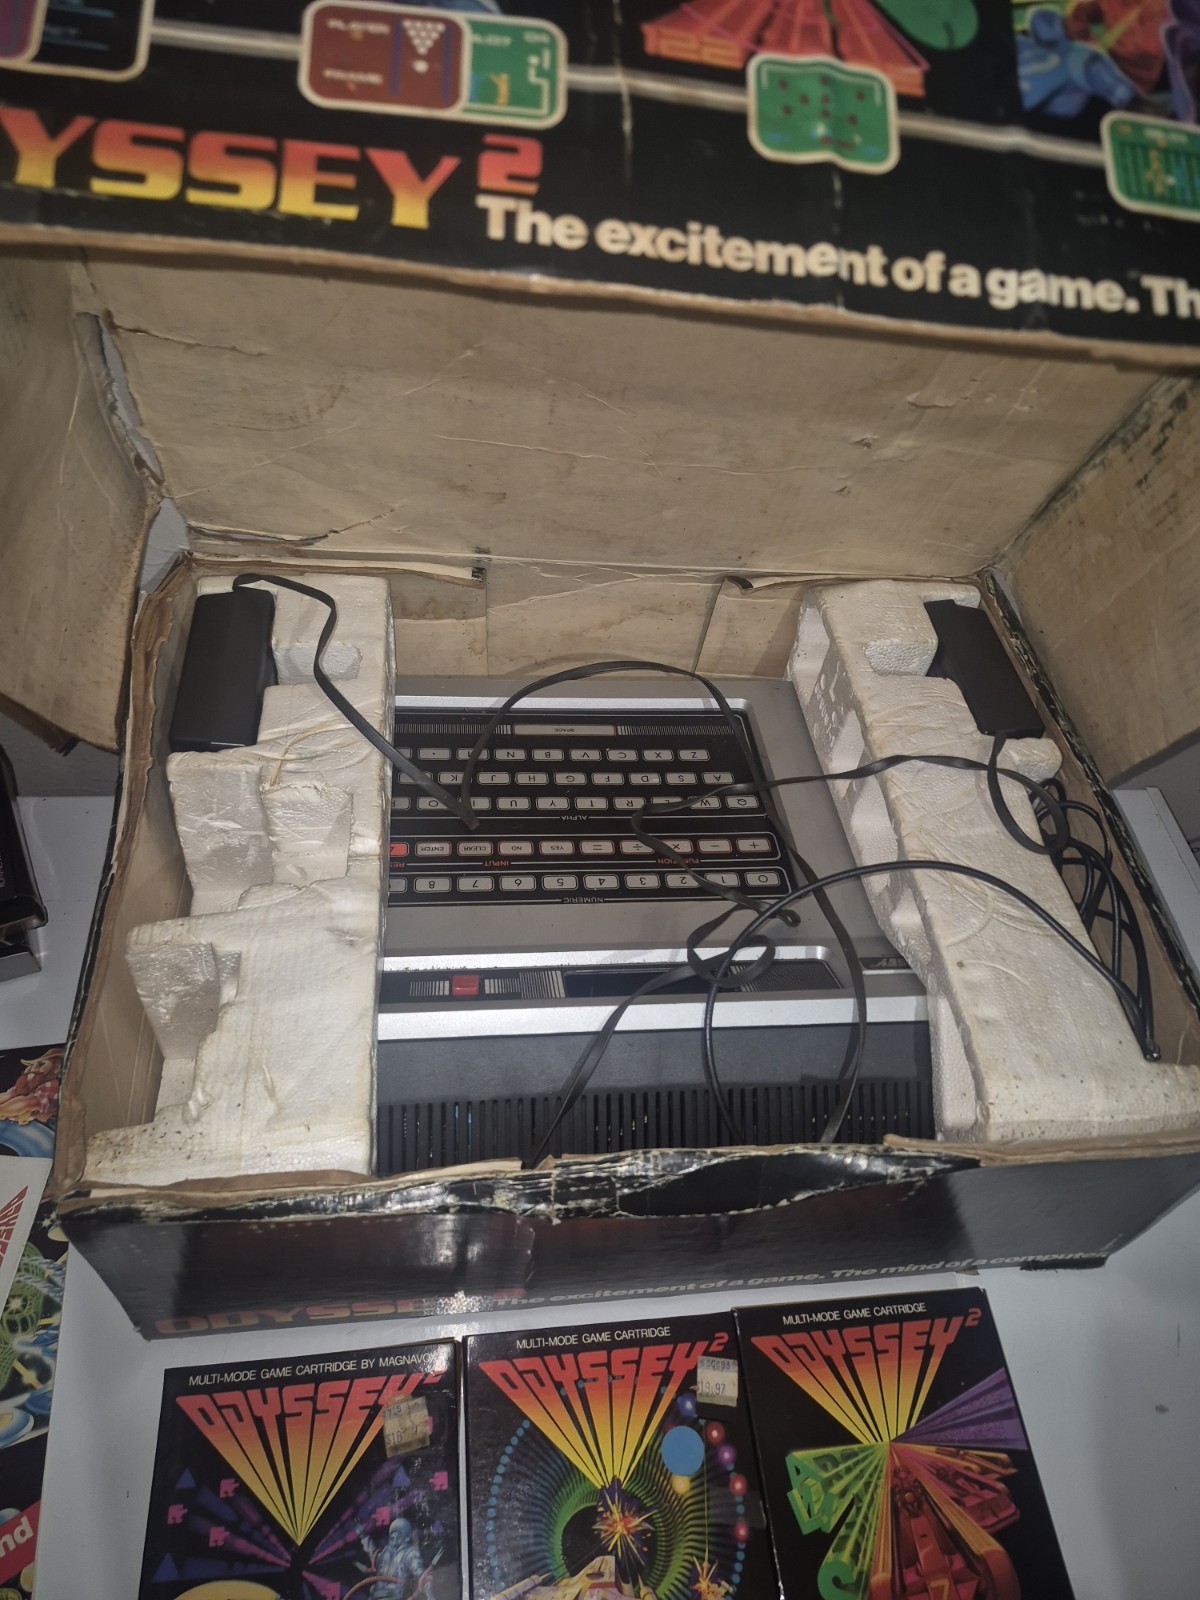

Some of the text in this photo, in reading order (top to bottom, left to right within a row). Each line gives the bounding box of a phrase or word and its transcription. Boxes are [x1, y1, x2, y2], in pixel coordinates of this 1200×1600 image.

[475, 194, 589, 250] The
[594, 218, 888, 287] excitement
[891, 250, 948, 293] of
[948, 264, 981, 298] a
[985, 268, 1141, 314] game.
[472, 880, 479, 888] 7
[515, 878, 523, 887] 6
[557, 878, 564, 886] 5
[639, 877, 646, 885] 3
[680, 876, 687, 884] 2
[429, 881, 435, 889] 8
[494, 1295, 543, 1306] The
[549, 1283, 696, 1301] excitement
[699, 1280, 726, 1289] of
[727, 1279, 744, 1287] a
[747, 1271, 825, 1287] game.
[832, 1267, 876, 1280] The
[880, 1261, 944, 1275] mind
[947, 1257, 974, 1269] of
[972, 1257, 988, 1267] a
[782, 1302, 927, 1325] MULTI-MODE GAME CARTRIDGE
[516, 1327, 671, 1349] MULTI-MODE GAME CARTRIDGE
[188, 1370, 257, 1386] MULTI-MODE
[260, 1366, 292, 1380] GAME
[296, 1359, 357, 1376] CARTRIDGE
[361, 1358, 375, 1369] BY
